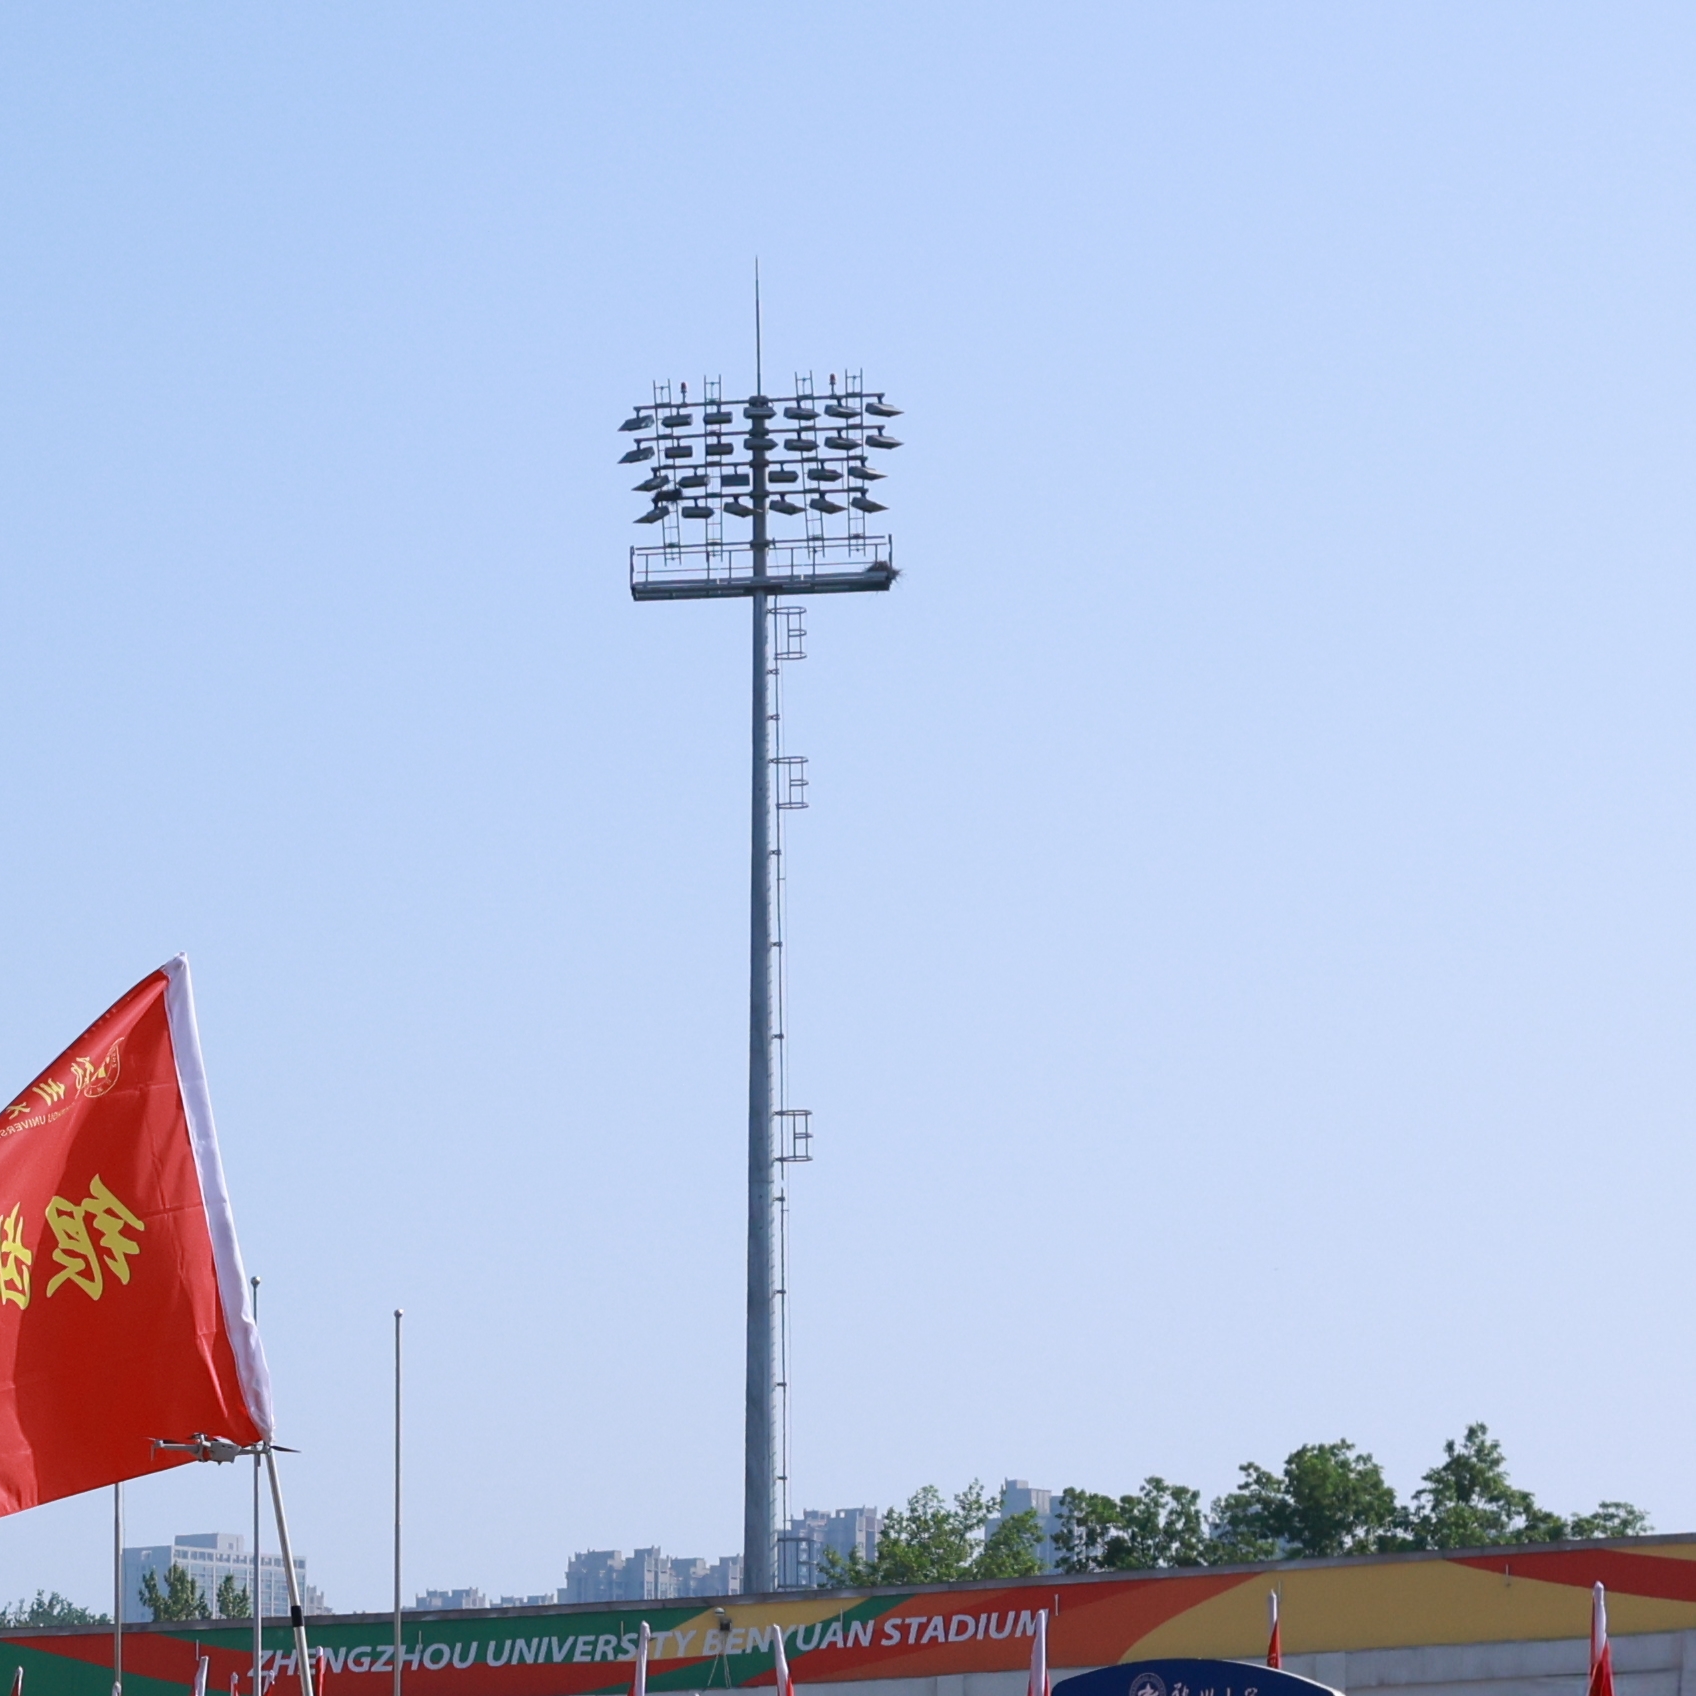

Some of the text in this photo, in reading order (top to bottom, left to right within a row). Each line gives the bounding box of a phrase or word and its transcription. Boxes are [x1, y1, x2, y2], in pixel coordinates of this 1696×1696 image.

[485, 1629, 692, 1668] UNIVERSTY
[702, 1618, 875, 1657] BENYUAN
[880, 1608, 1050, 1648] STADIUM
